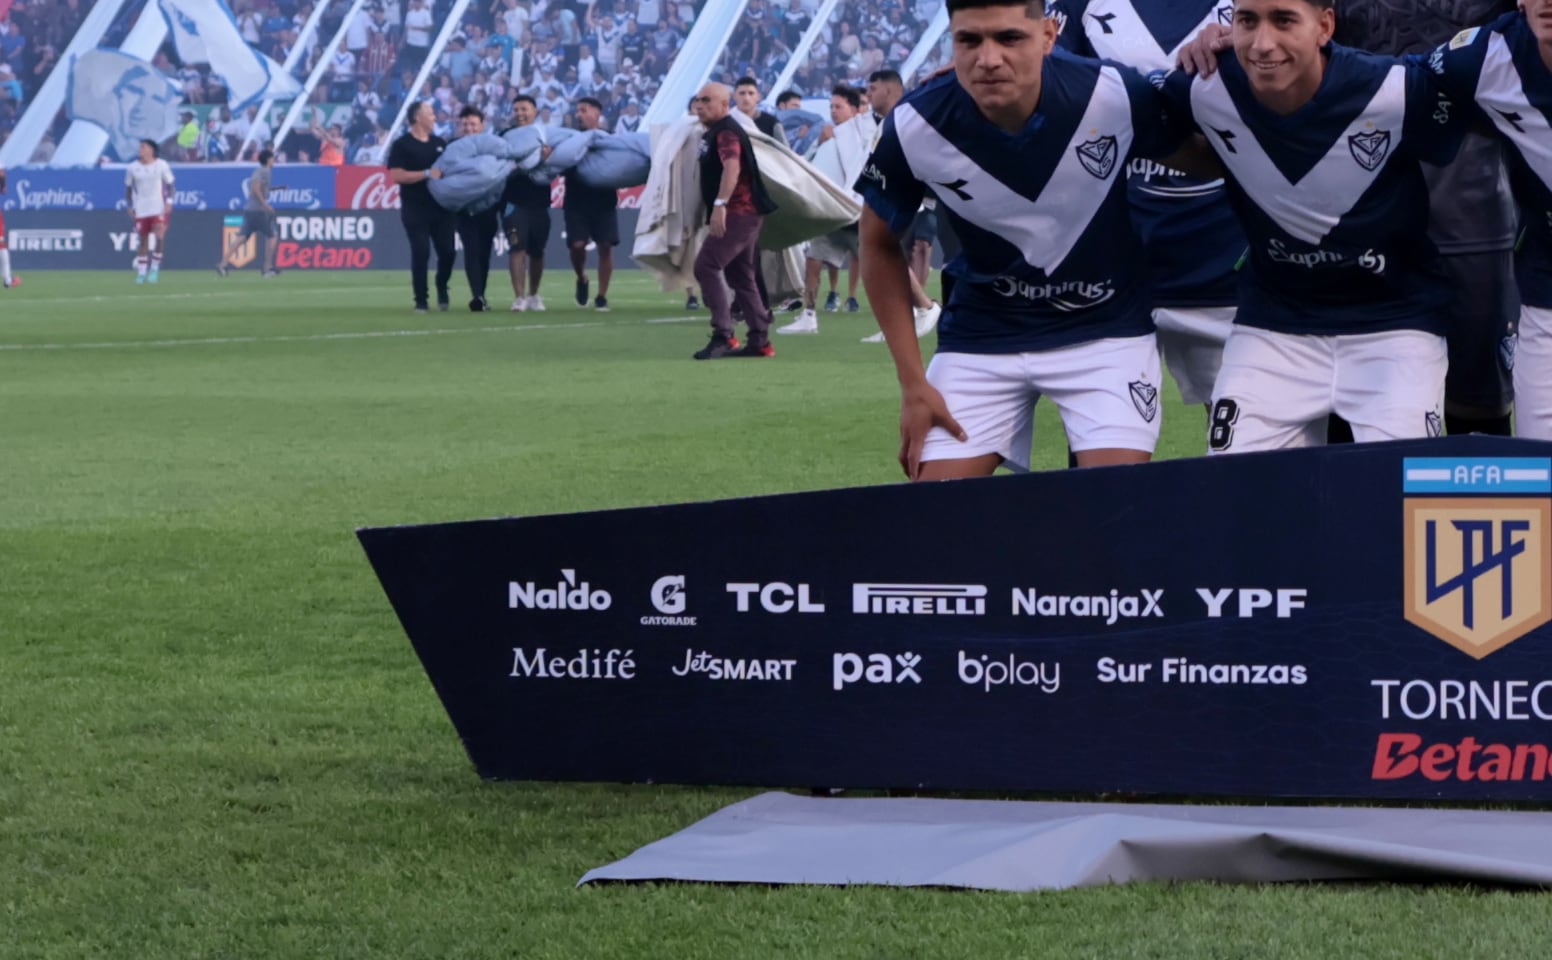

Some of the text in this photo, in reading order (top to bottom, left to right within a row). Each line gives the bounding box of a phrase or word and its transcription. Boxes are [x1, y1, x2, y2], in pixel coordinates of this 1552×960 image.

[8, 229, 83, 252] PIRELLI
[276, 216, 374, 240] TORNEO
[275, 243, 372, 268] Betano
[1210, 399, 1240, 451] 8
[1453, 465, 1501, 484] AFA
[509, 569, 612, 610] Naldo
[726, 583, 825, 613] TCL
[853, 583, 988, 615] PIRELLI
[1196, 588, 1307, 618] YPF
[640, 616, 697, 626] GATORADE
[1012, 588, 1164, 625] NaranjaX
[510, 647, 636, 679] Medifé
[671, 648, 797, 681] JetSMART
[833, 651, 922, 691] pax
[958, 650, 1060, 693] bplay
[1097, 656, 1308, 685] Sur Finanzas
